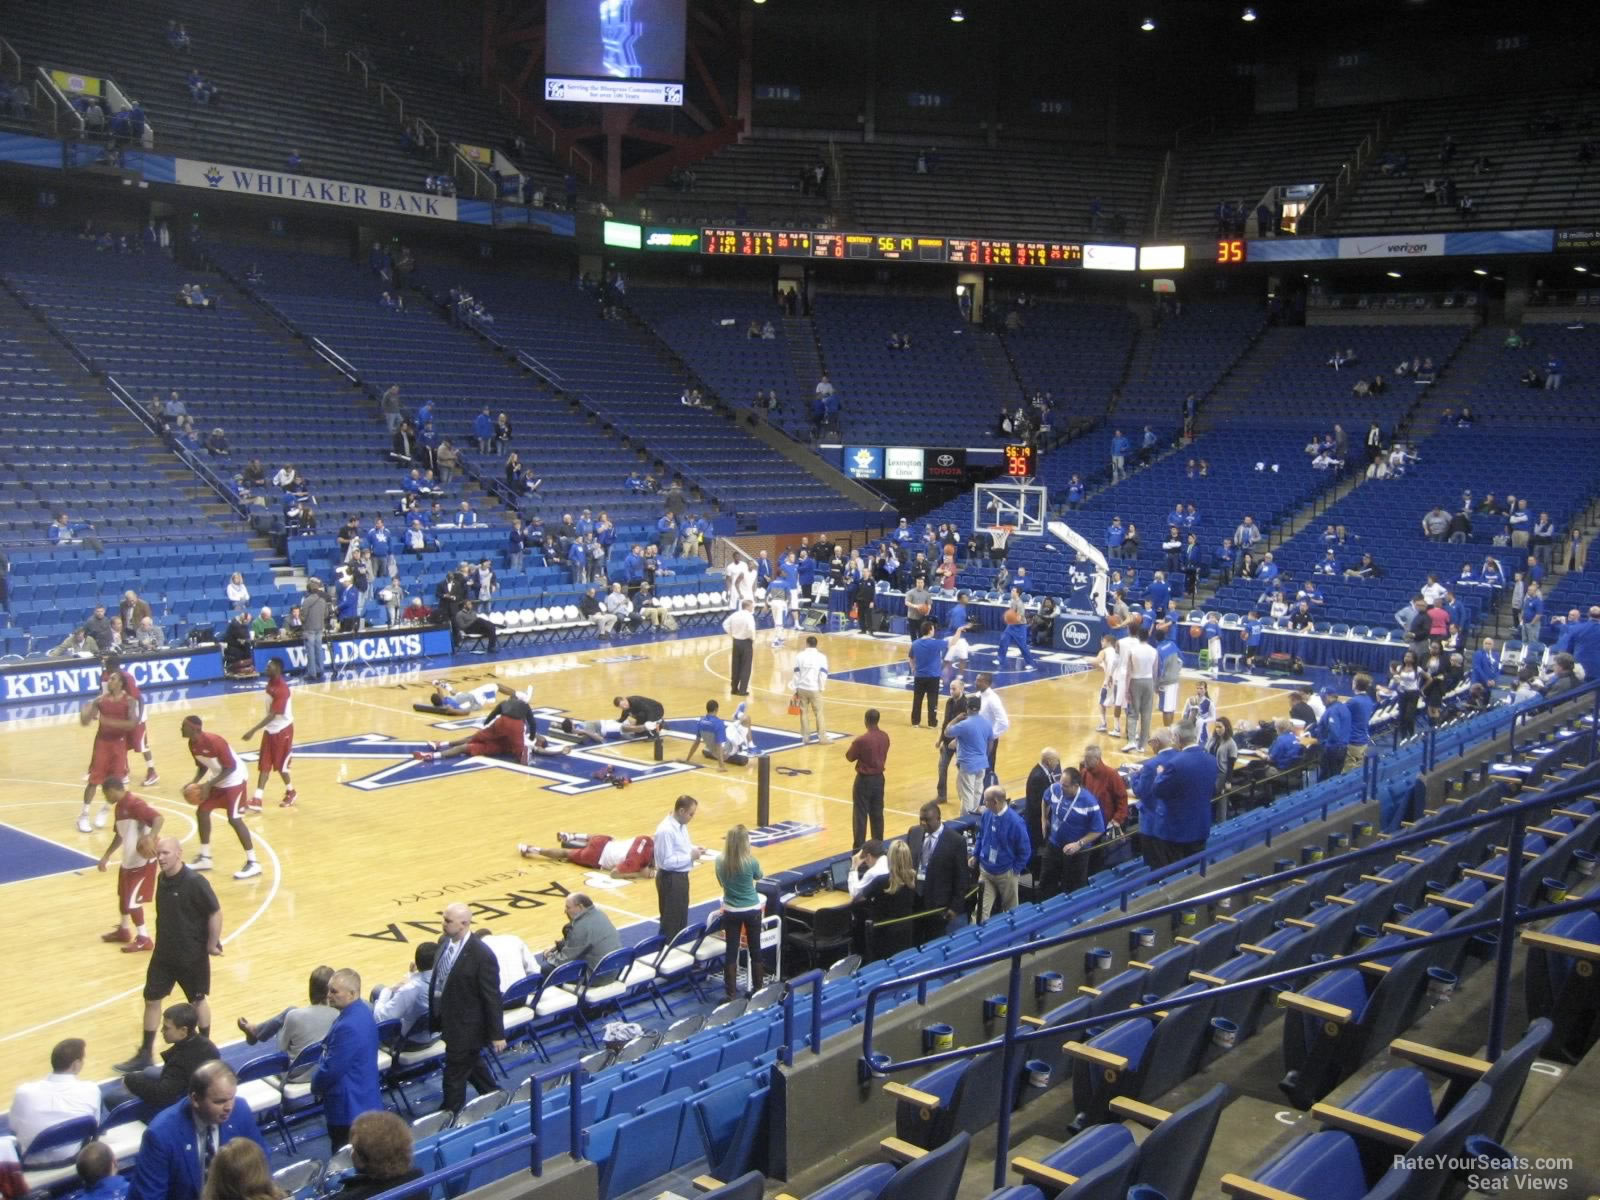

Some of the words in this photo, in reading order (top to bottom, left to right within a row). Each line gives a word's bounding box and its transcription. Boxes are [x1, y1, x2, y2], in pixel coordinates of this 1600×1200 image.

[232, 171, 367, 206] WHITAKER
[379, 191, 439, 216] BANK
[1218, 240, 1243, 263] 35
[1388, 242, 1427, 254] verizon
[888, 459, 922, 471] Lexington
[928, 467, 962, 476] TOYOTA
[1008, 457, 1027, 476] 35
[1065, 625, 1088, 645] Kroger
[285, 633, 422, 668] WLDCATS
[4, 657, 192, 700] KENTCKY
[392, 868, 528, 906] KENTUCKY
